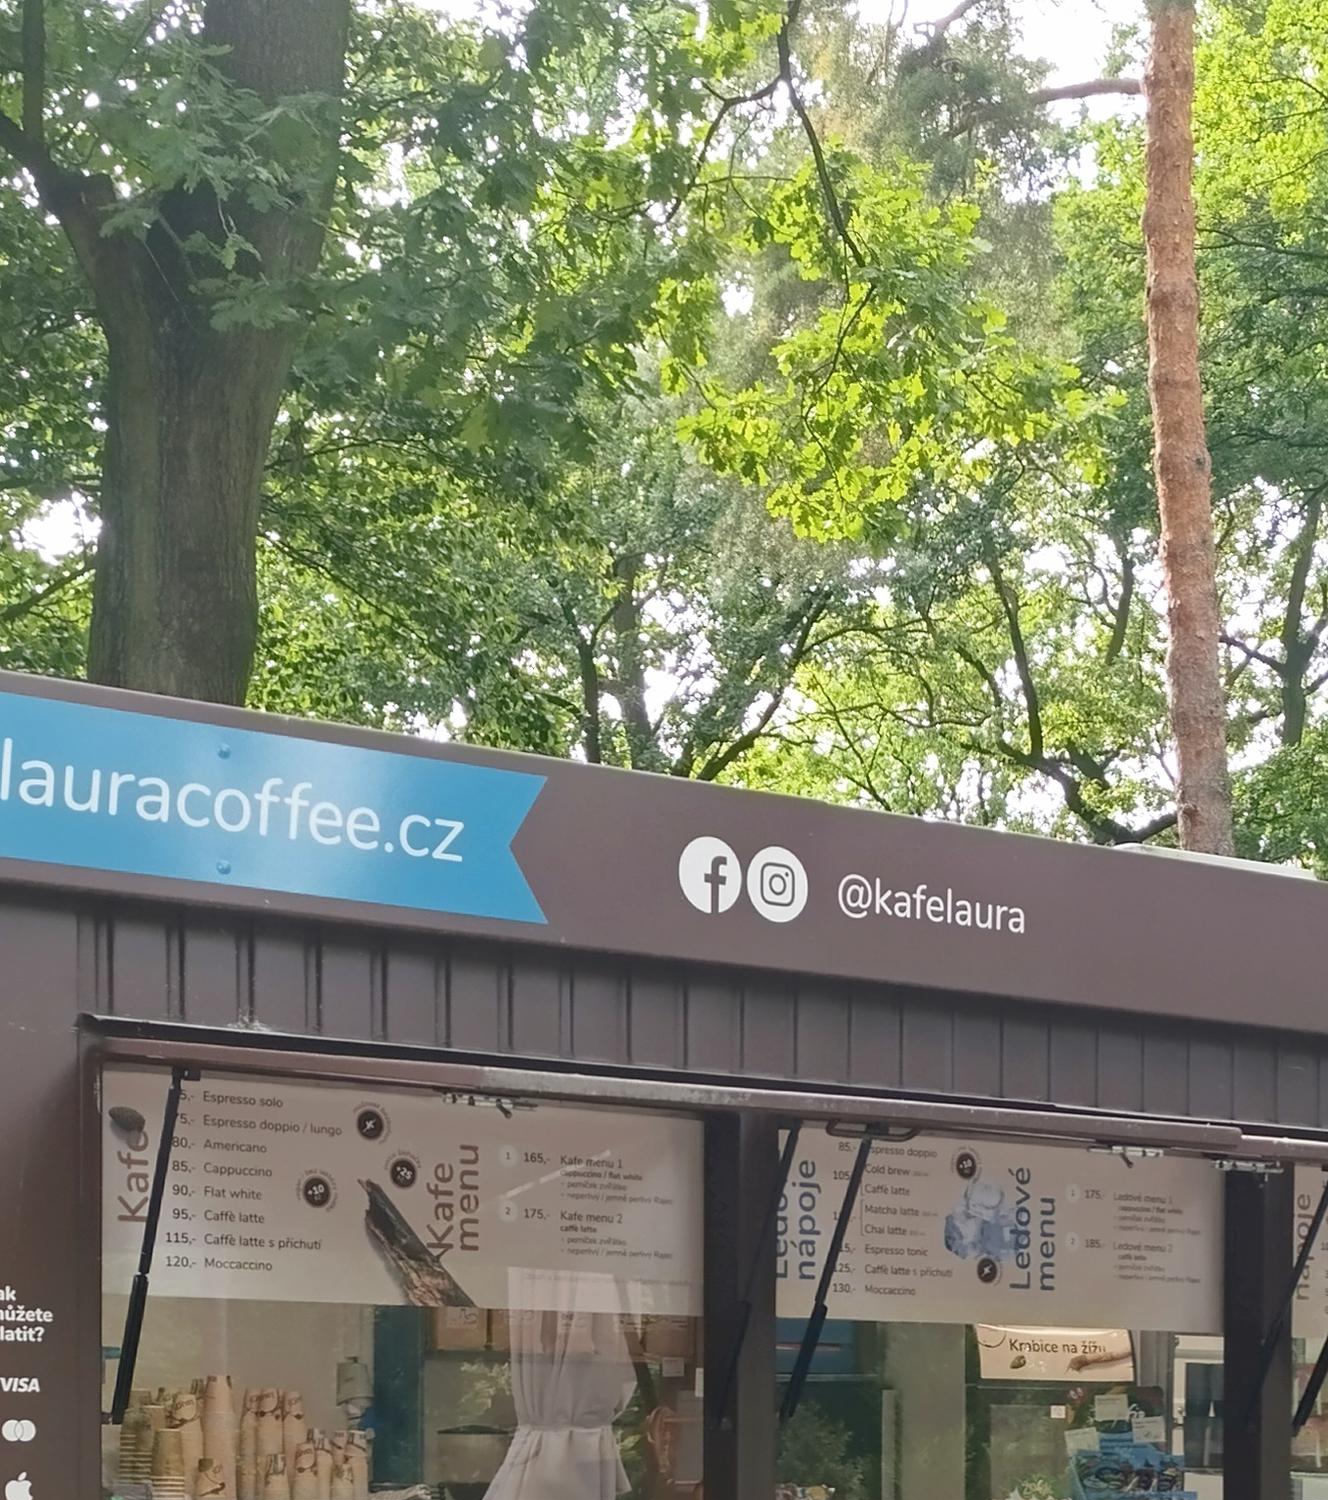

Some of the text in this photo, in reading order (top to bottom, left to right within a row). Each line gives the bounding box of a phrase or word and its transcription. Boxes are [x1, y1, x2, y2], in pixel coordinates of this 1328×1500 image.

[837, 871, 1026, 934] @kafelaura
[203, 1090, 283, 1108] Espresso solo
[203, 1114, 256, 1130] Espresso
[259, 1119, 300, 1133] doppio
[310, 1123, 343, 1137] lungo
[203, 1138, 267, 1153] Americano
[871, 1145, 904, 1158] spresso
[560, 1154, 584, 1167] Kafe
[586, 1158, 615, 1169] menu
[203, 1162, 273, 1178] Cappuccino
[203, 1186, 227, 1199] Flat
[229, 1187, 263, 1200] white
[459, 1144, 480, 1252] menu
[203, 1209, 235, 1222] Caffè
[238, 1211, 265, 1224] latte
[426, 1162, 454, 1261] Kafe
[560, 1210, 584, 1222] Kafe
[586, 1213, 615, 1224] menu
[791, 1159, 821, 1281] nápoje
[1008, 1167, 1031, 1290] Ledové
[204, 1232, 236, 1246] Caffè
[238, 1235, 265, 1248] latte
[268, 1238, 275, 1248] s
[1039, 1197, 1056, 1292] menu
[204, 1257, 273, 1272] Moccaccino
[1009, 1338, 1060, 1354] Krabice
[1062, 1342, 1078, 1354] na
